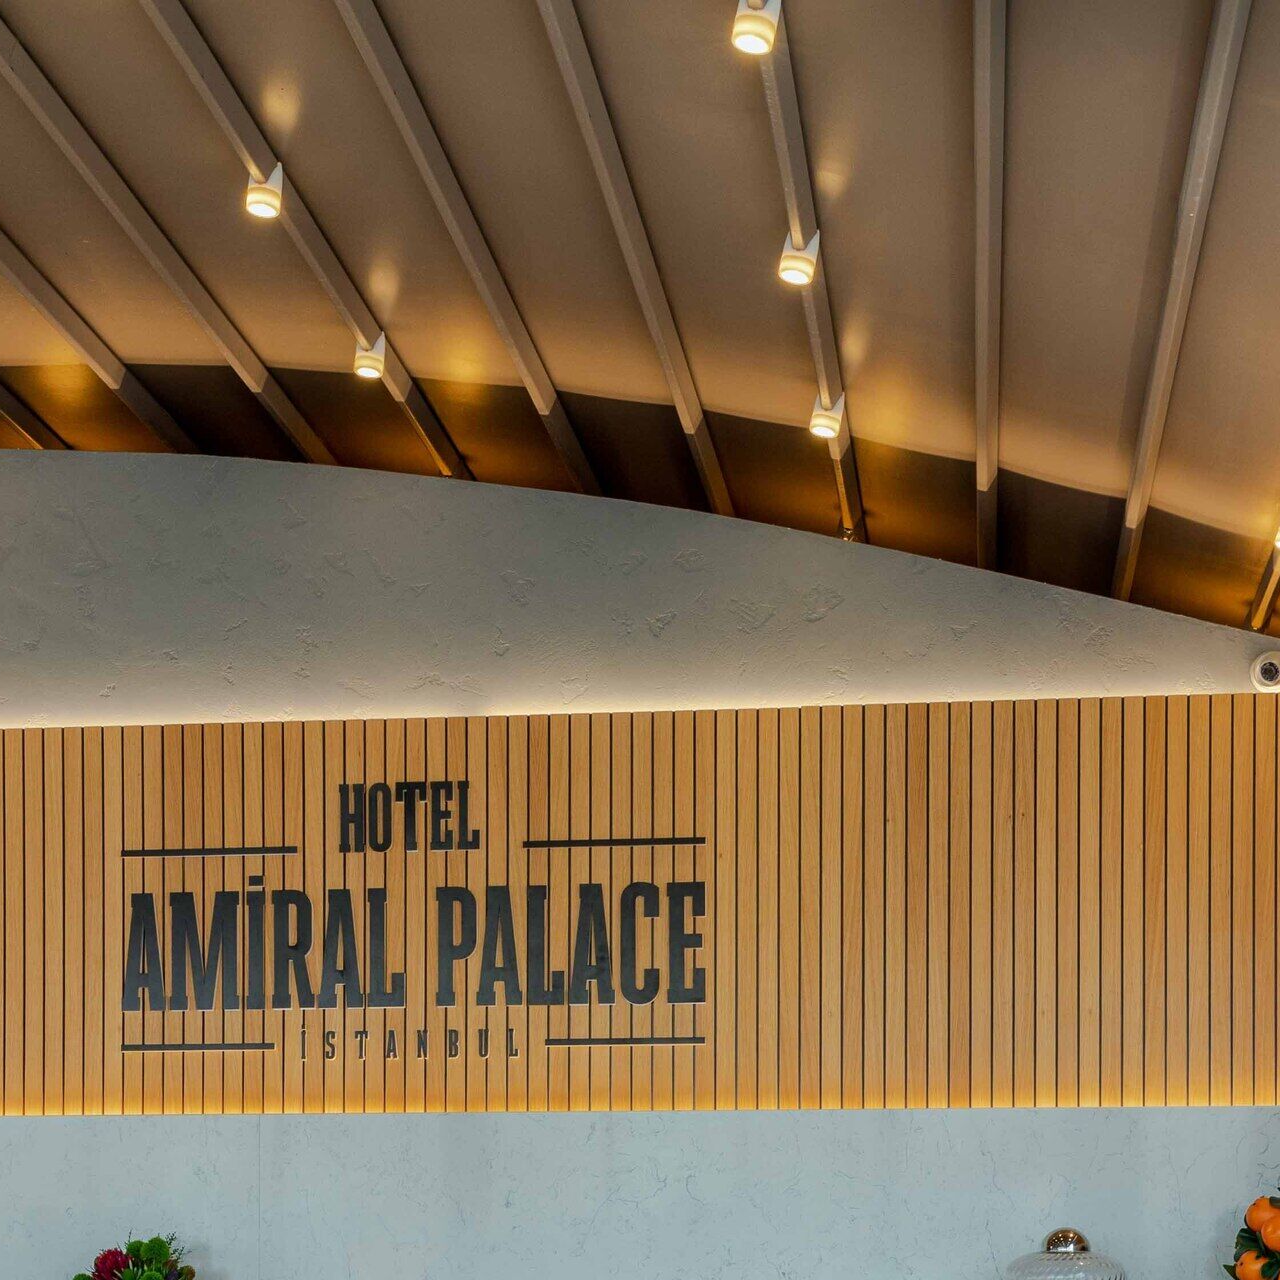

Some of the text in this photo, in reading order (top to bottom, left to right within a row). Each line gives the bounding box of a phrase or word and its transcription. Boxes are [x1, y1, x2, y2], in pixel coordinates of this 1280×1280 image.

[338, 780, 481, 853] HOTEL
[120, 875, 706, 1012] AMİRAL PALACE
[300, 1024, 520, 1061] İSTANBUL
